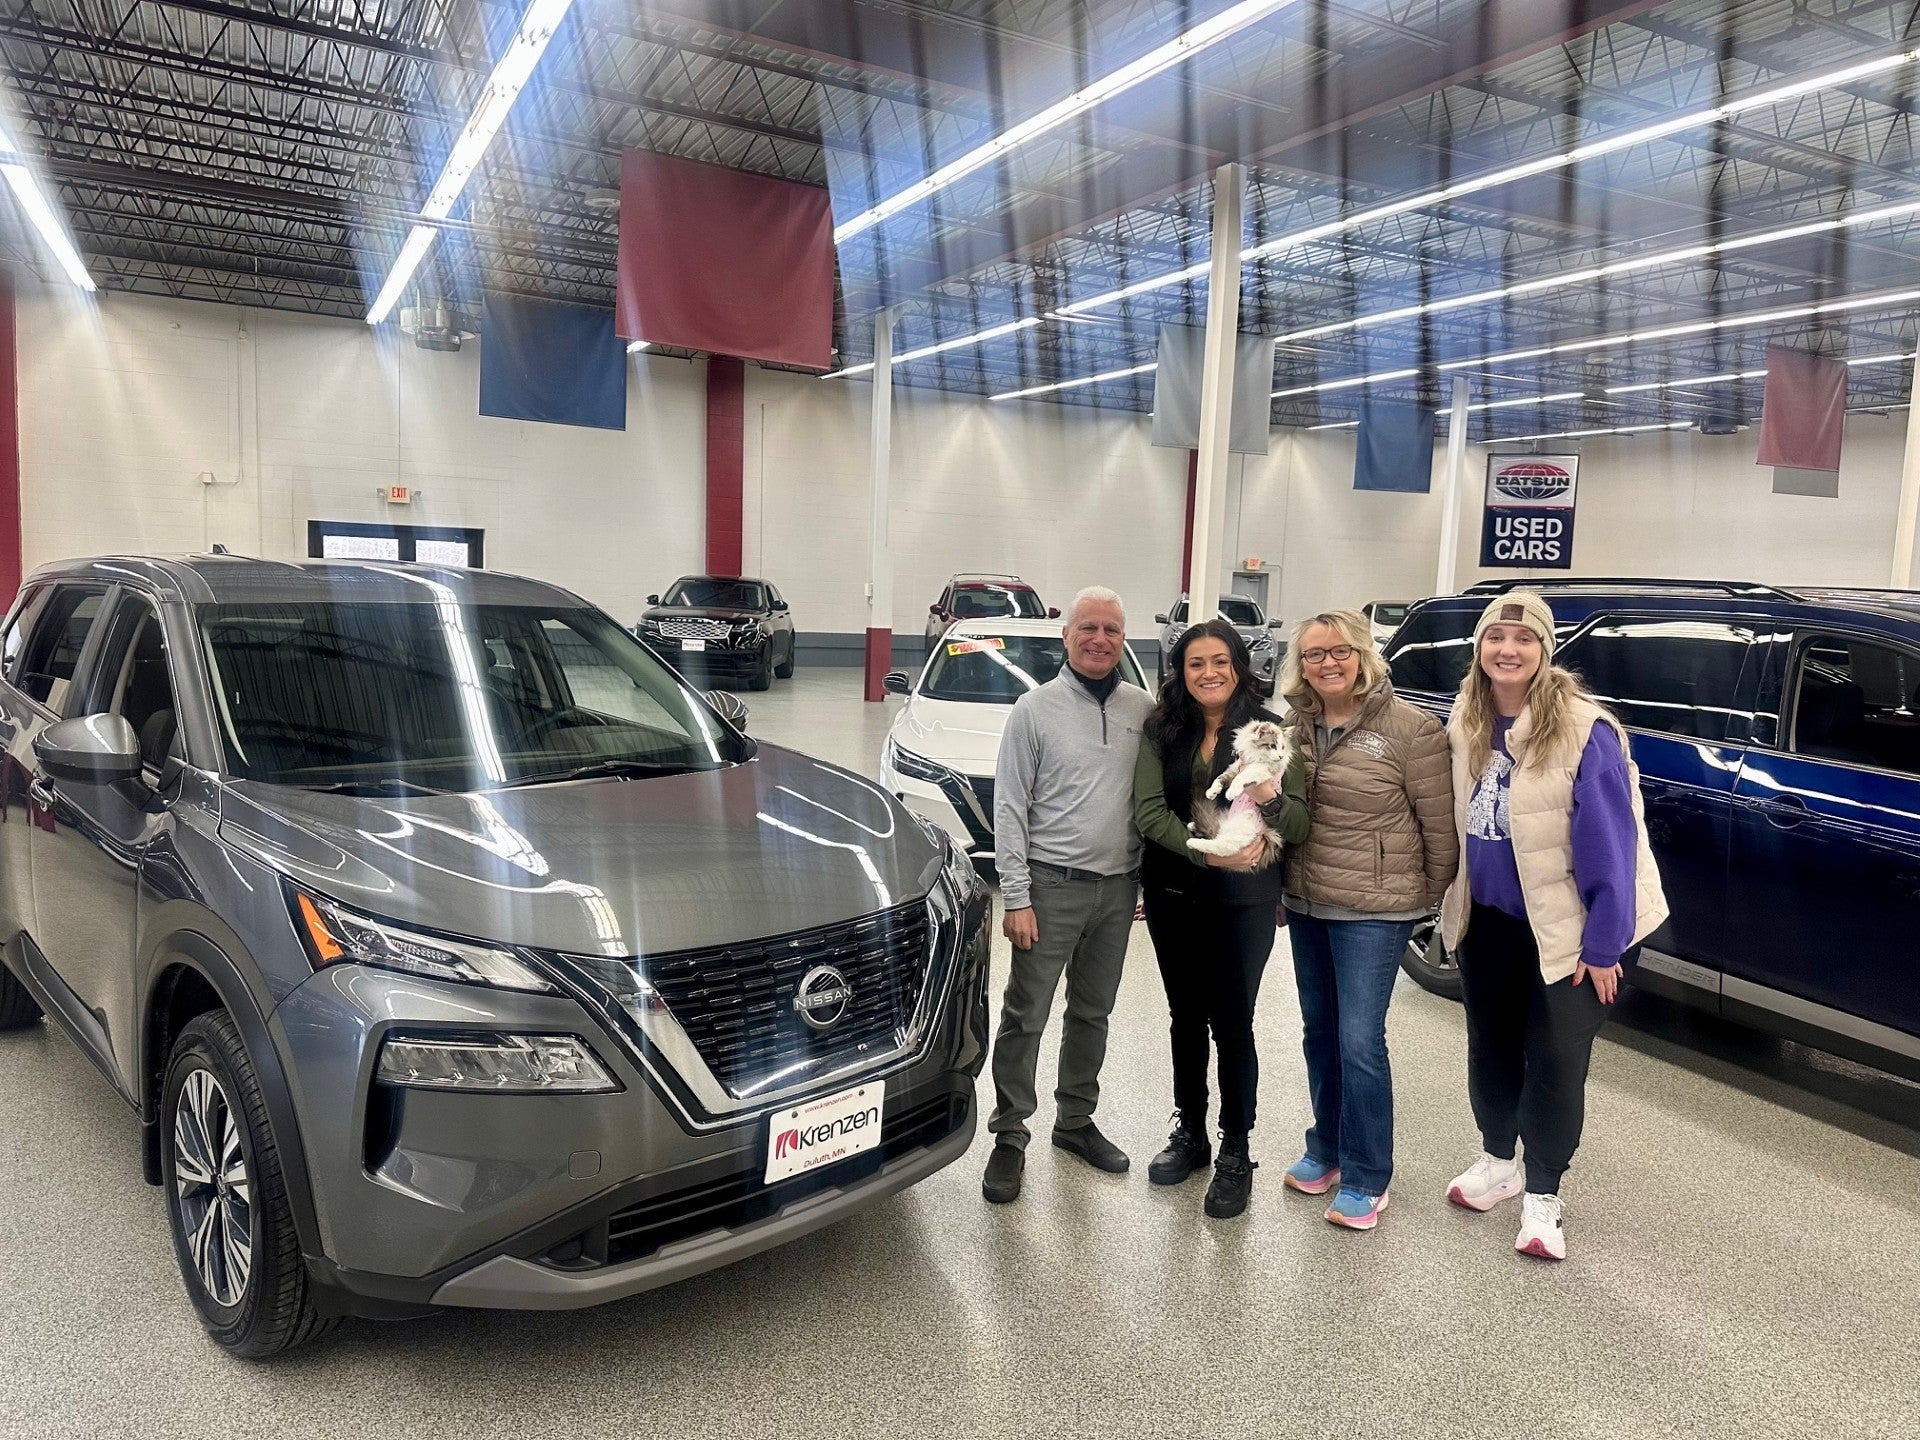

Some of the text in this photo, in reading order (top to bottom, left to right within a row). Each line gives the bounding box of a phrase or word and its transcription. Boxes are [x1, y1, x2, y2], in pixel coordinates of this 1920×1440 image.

[1496, 477, 1569, 486] DATSUN
[391, 487, 407, 498] EXIT
[1495, 517, 1563, 537] USED
[1494, 539, 1561, 560] CARS
[795, 986, 851, 1009] NISSAN
[799, 1106, 878, 1150] Krenzen
[832, 1147, 847, 1158] MN
